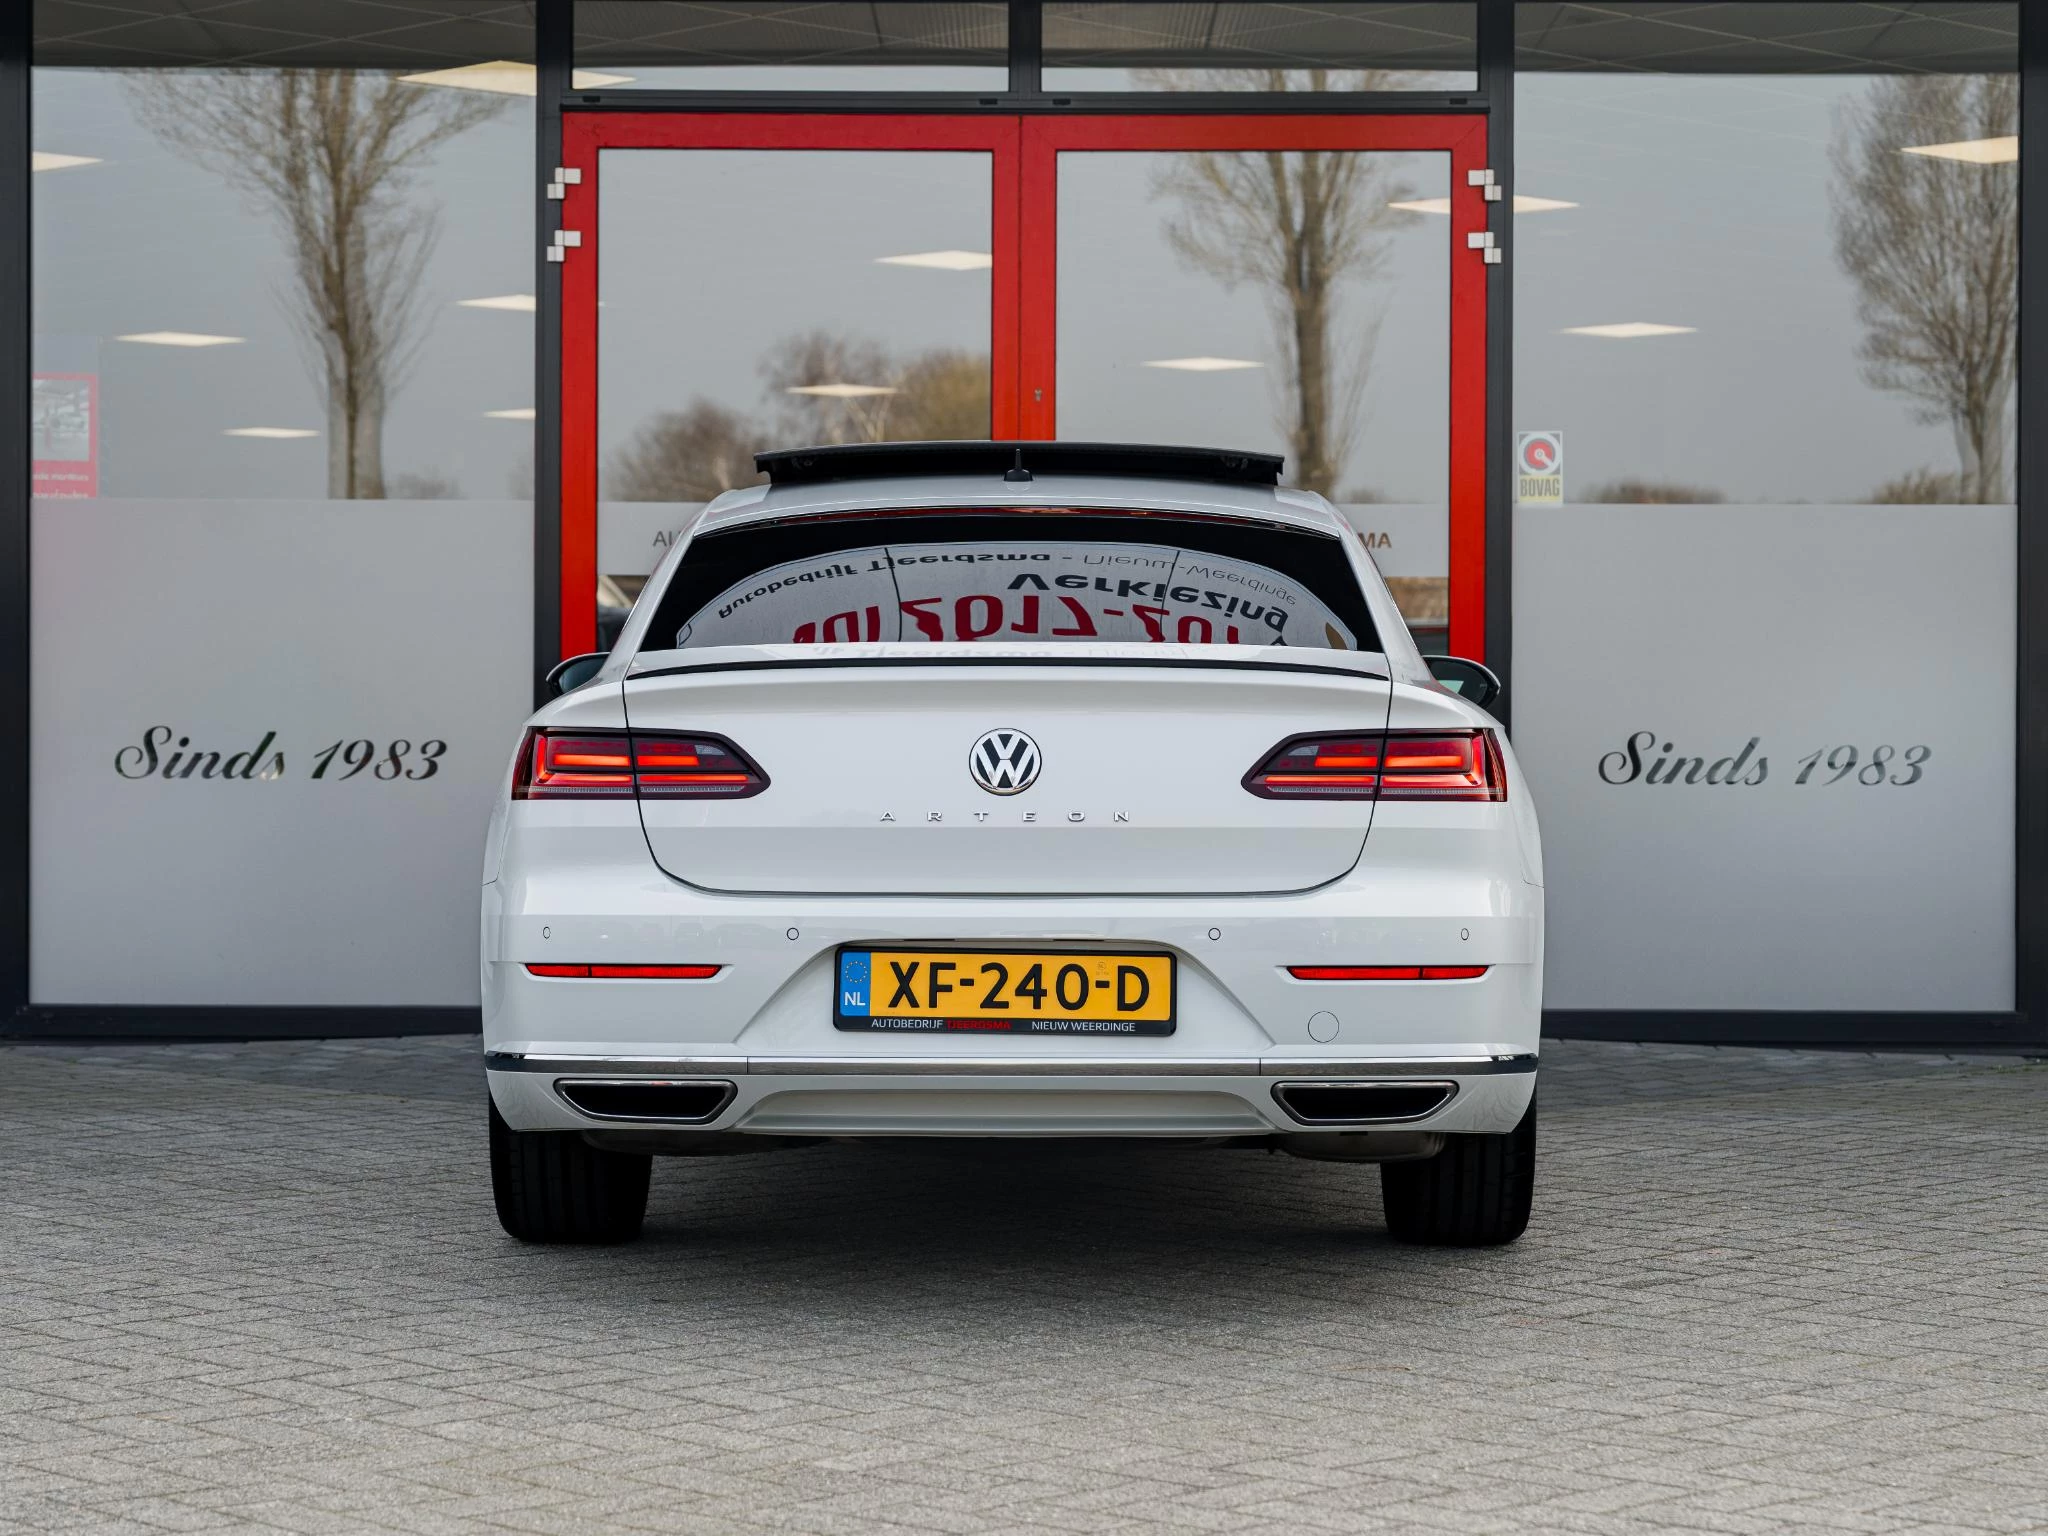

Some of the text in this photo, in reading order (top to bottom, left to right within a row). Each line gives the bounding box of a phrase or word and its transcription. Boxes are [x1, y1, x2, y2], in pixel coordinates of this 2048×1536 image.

[1520, 477, 1561, 497] BOVAG
[114, 725, 448, 782] Sinds 1983
[1598, 730, 1932, 787] Sinds 1983
[879, 810, 1130, 823] ARTEON
[887, 960, 1151, 1012] XF-240-D
[843, 992, 866, 1007] NL
[871, 1018, 943, 1030] AUTOBEDRIJF
[1031, 1020, 1069, 1032] NIEUW
[1071, 1020, 1136, 1033] WEERDINGE
